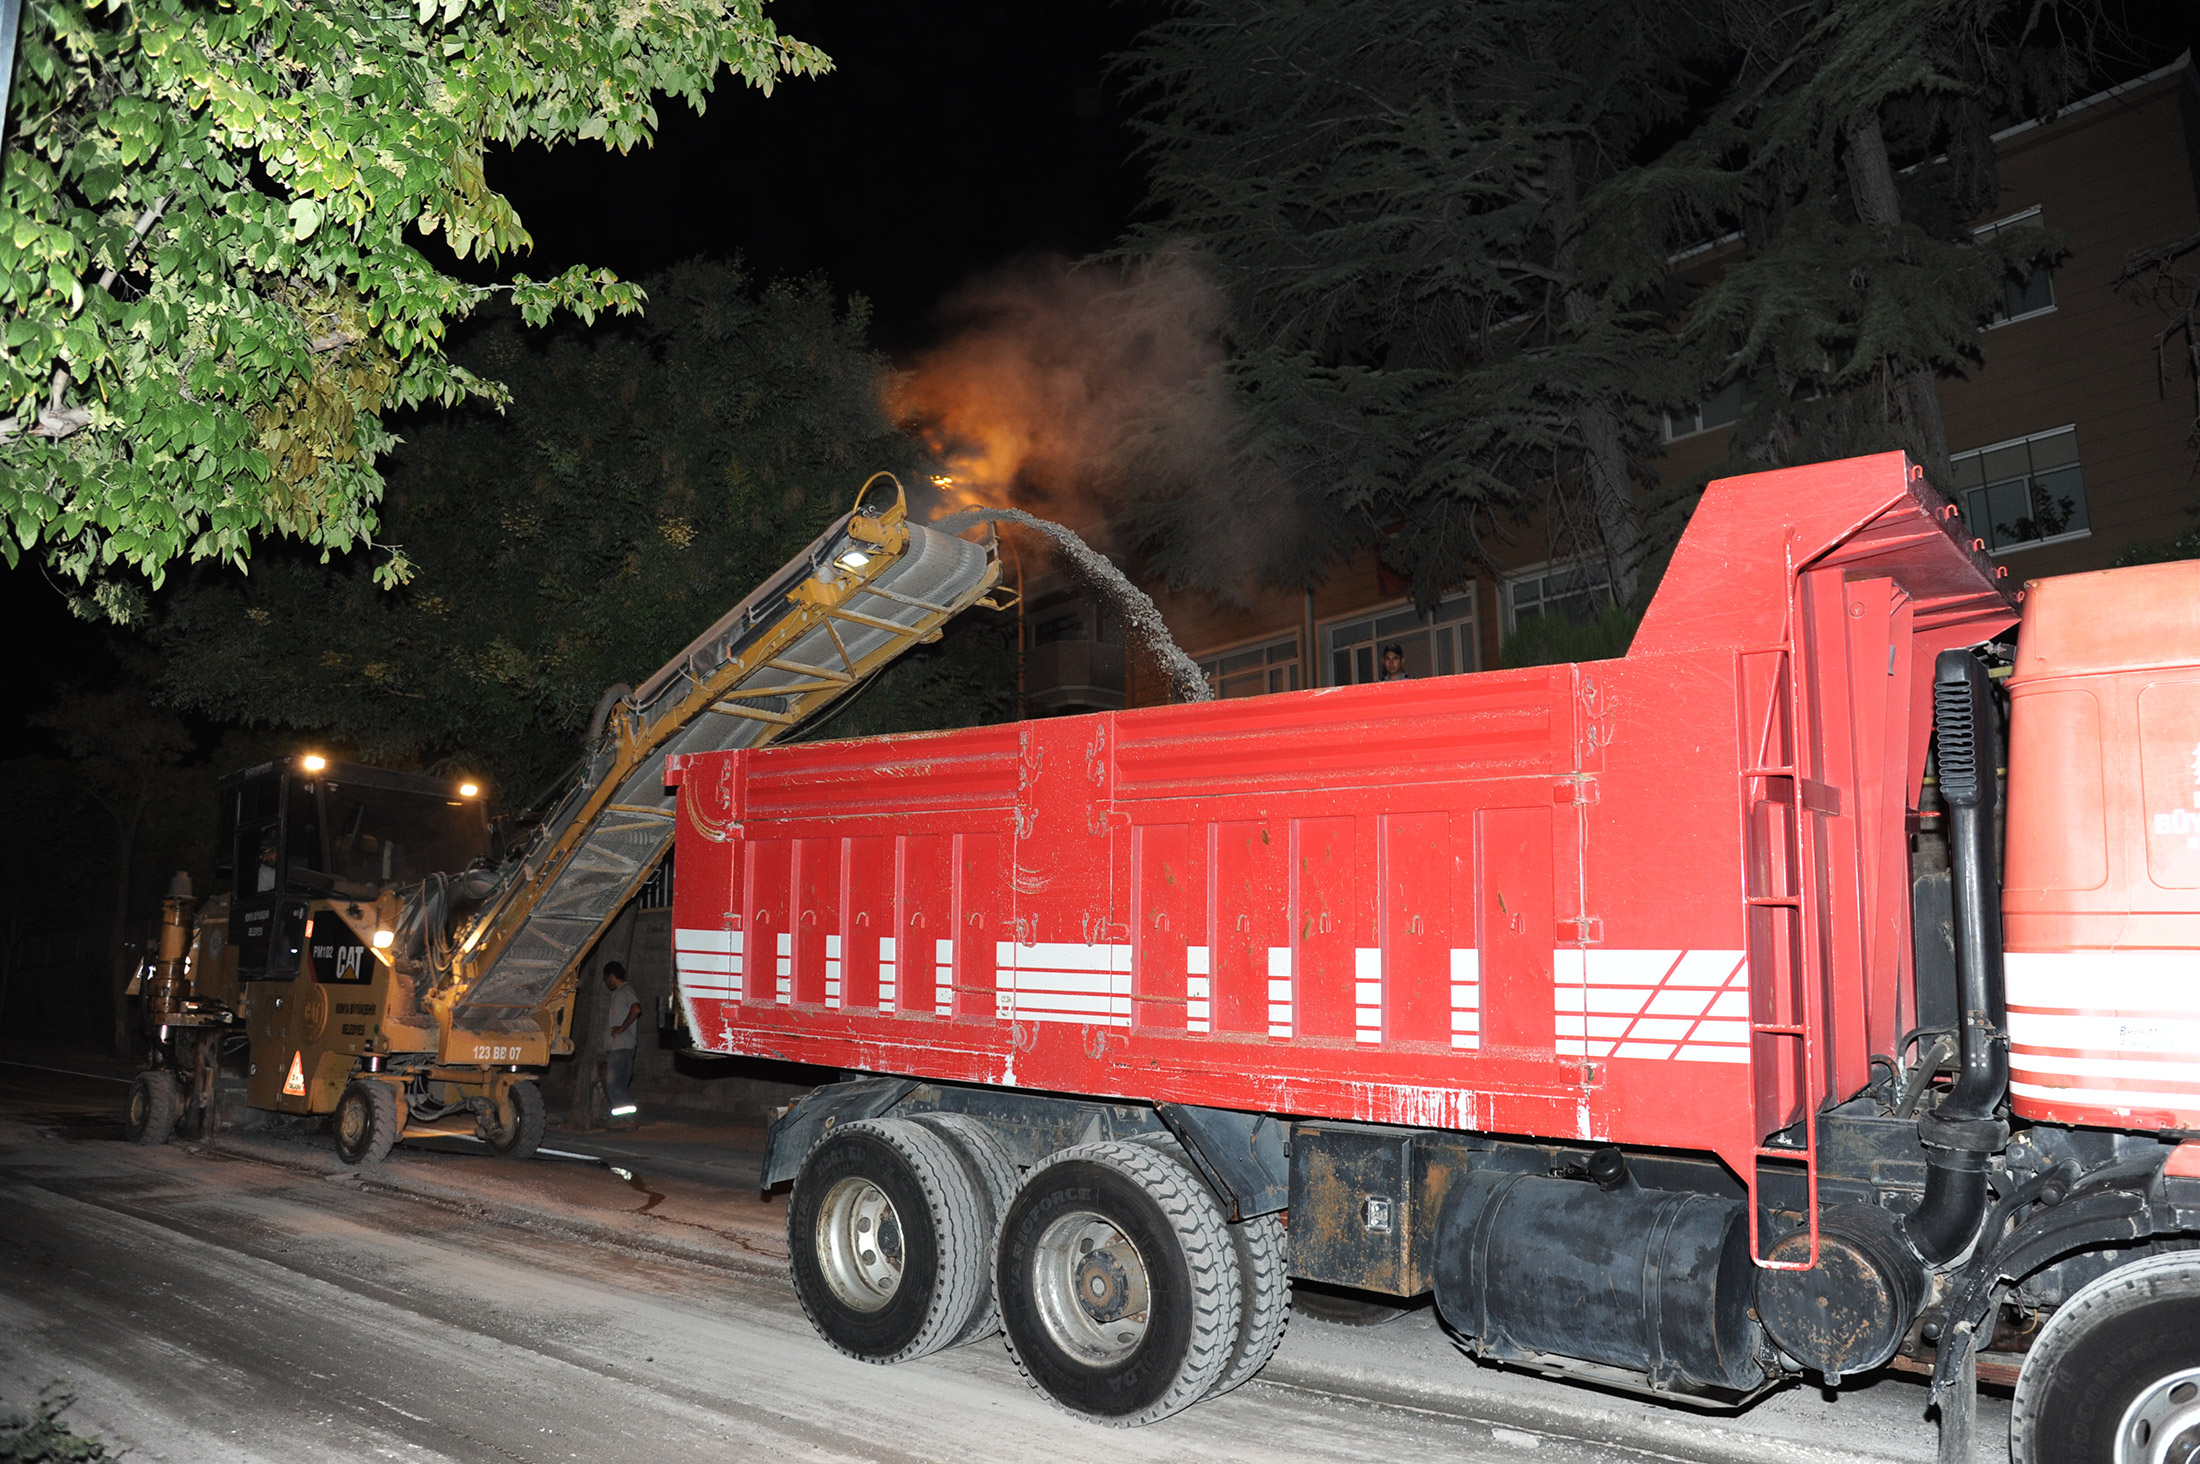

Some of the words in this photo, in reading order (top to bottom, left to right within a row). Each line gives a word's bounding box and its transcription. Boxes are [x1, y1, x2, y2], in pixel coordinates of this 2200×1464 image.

[313, 945, 334, 959] PM102
[336, 945, 365, 980] CAT
[473, 1045, 491, 1060] 123
[509, 1046, 522, 1060] 07
[1010, 1187, 1092, 1297] VARIOFORCE
